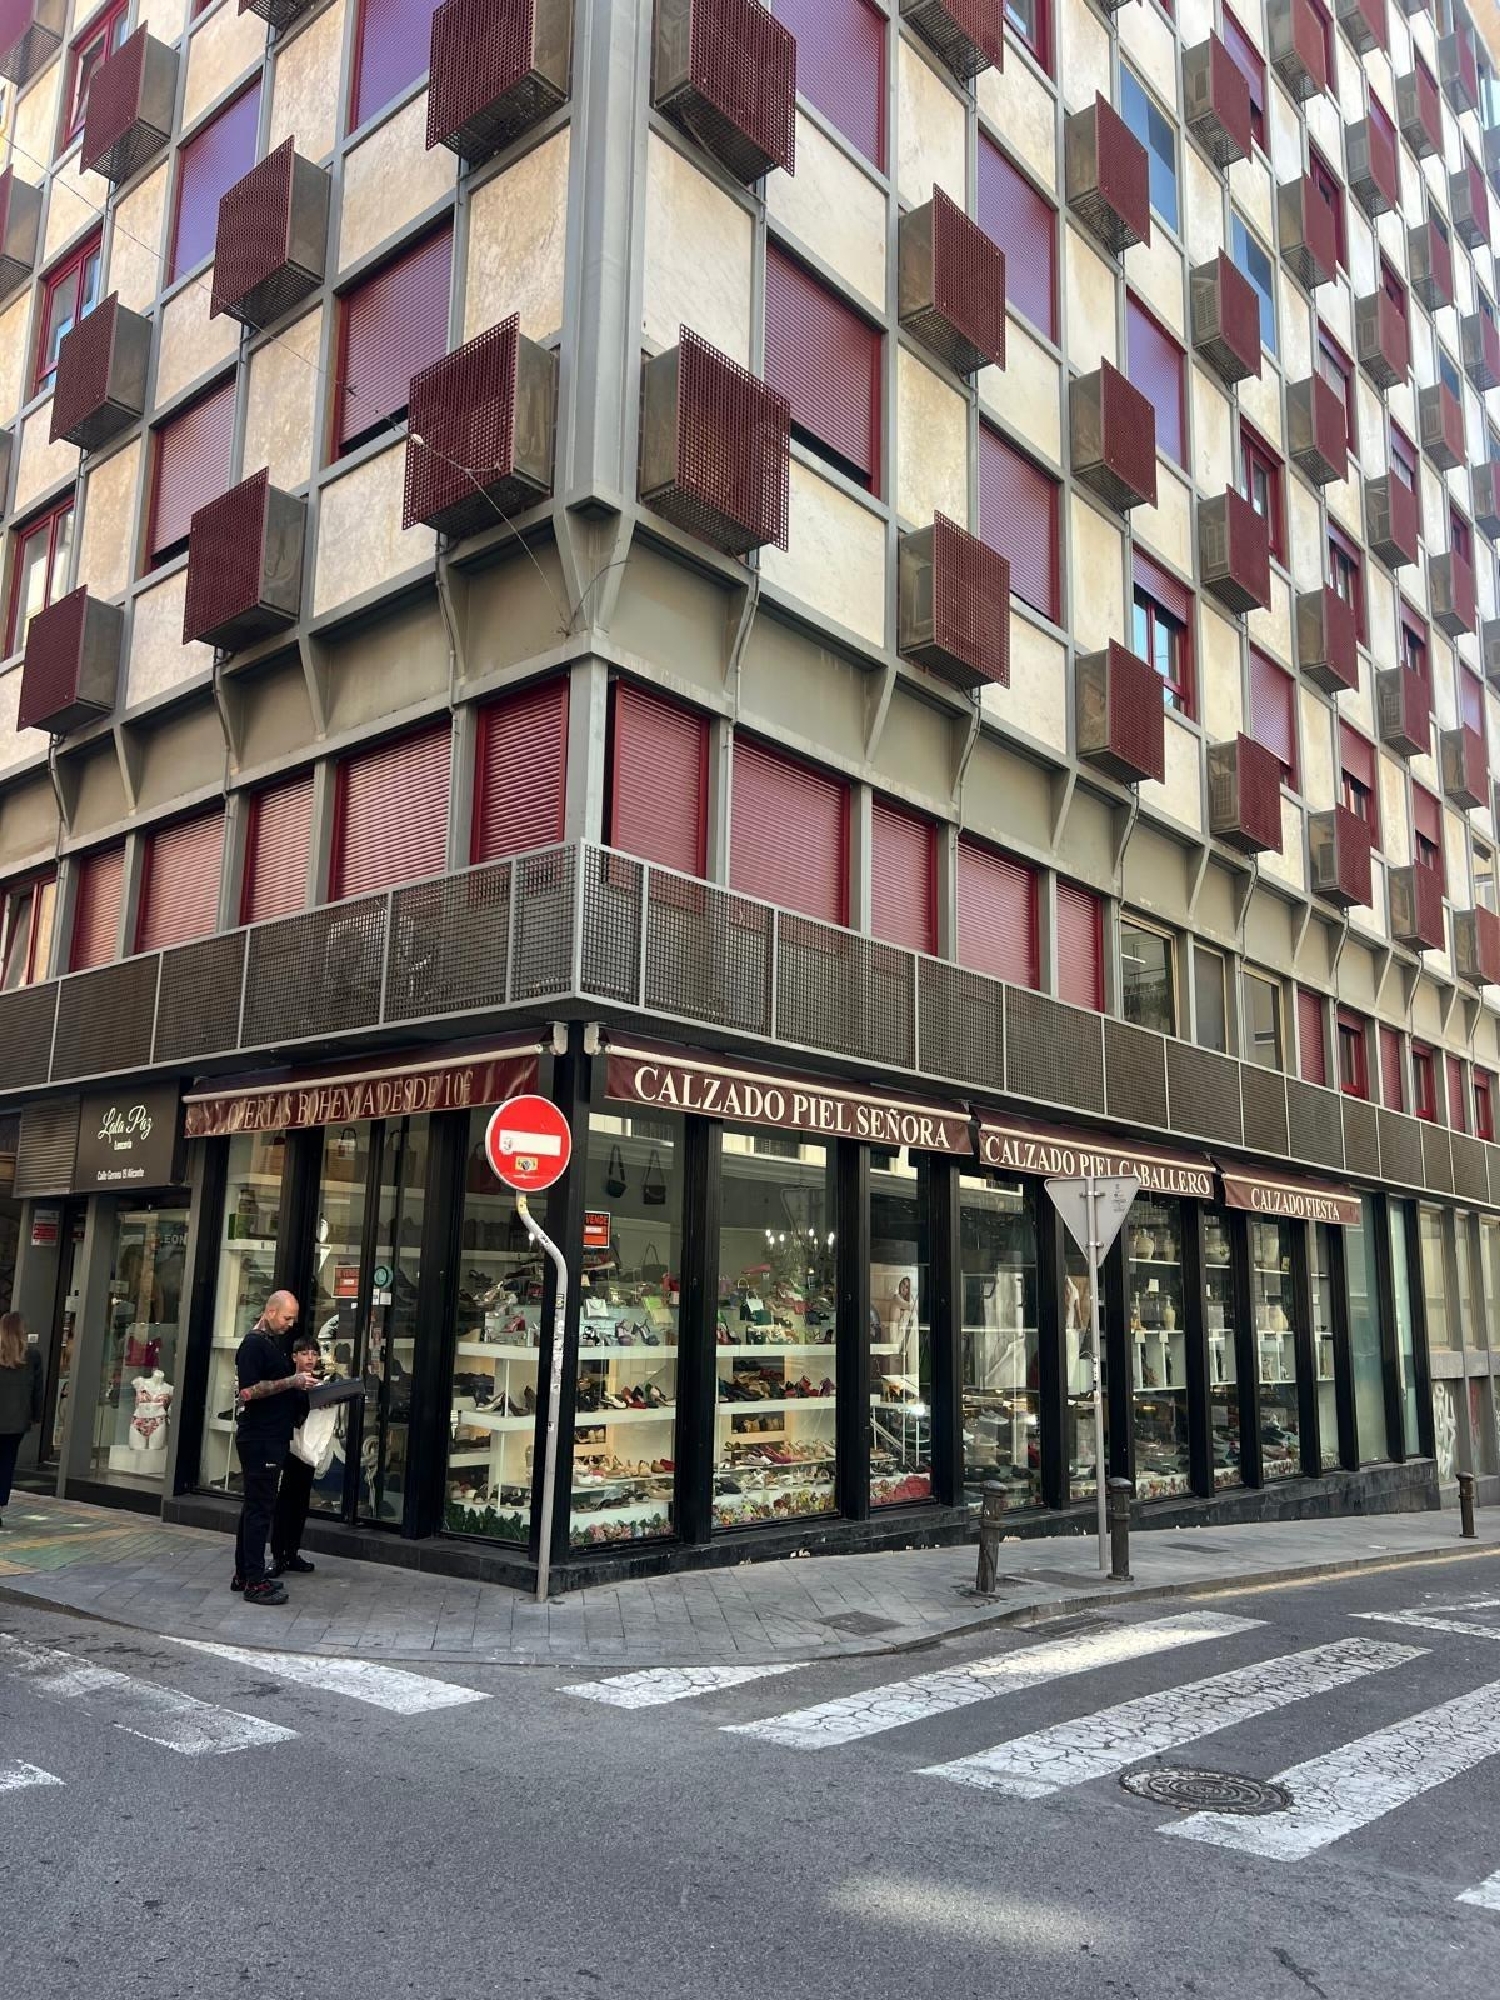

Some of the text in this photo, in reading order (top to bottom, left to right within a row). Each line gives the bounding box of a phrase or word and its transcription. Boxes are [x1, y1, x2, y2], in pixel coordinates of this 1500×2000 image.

[227, 1093, 291, 1132] OFERTAS
[377, 1074, 440, 1114] DESDE
[444, 1069, 474, 1106] 10€
[634, 1065, 951, 1149] CALZADO PIEL SEÑORA
[985, 1135, 1076, 1176] CALZADO
[1250, 1187, 1340, 1221] CALZADO FIESTA
